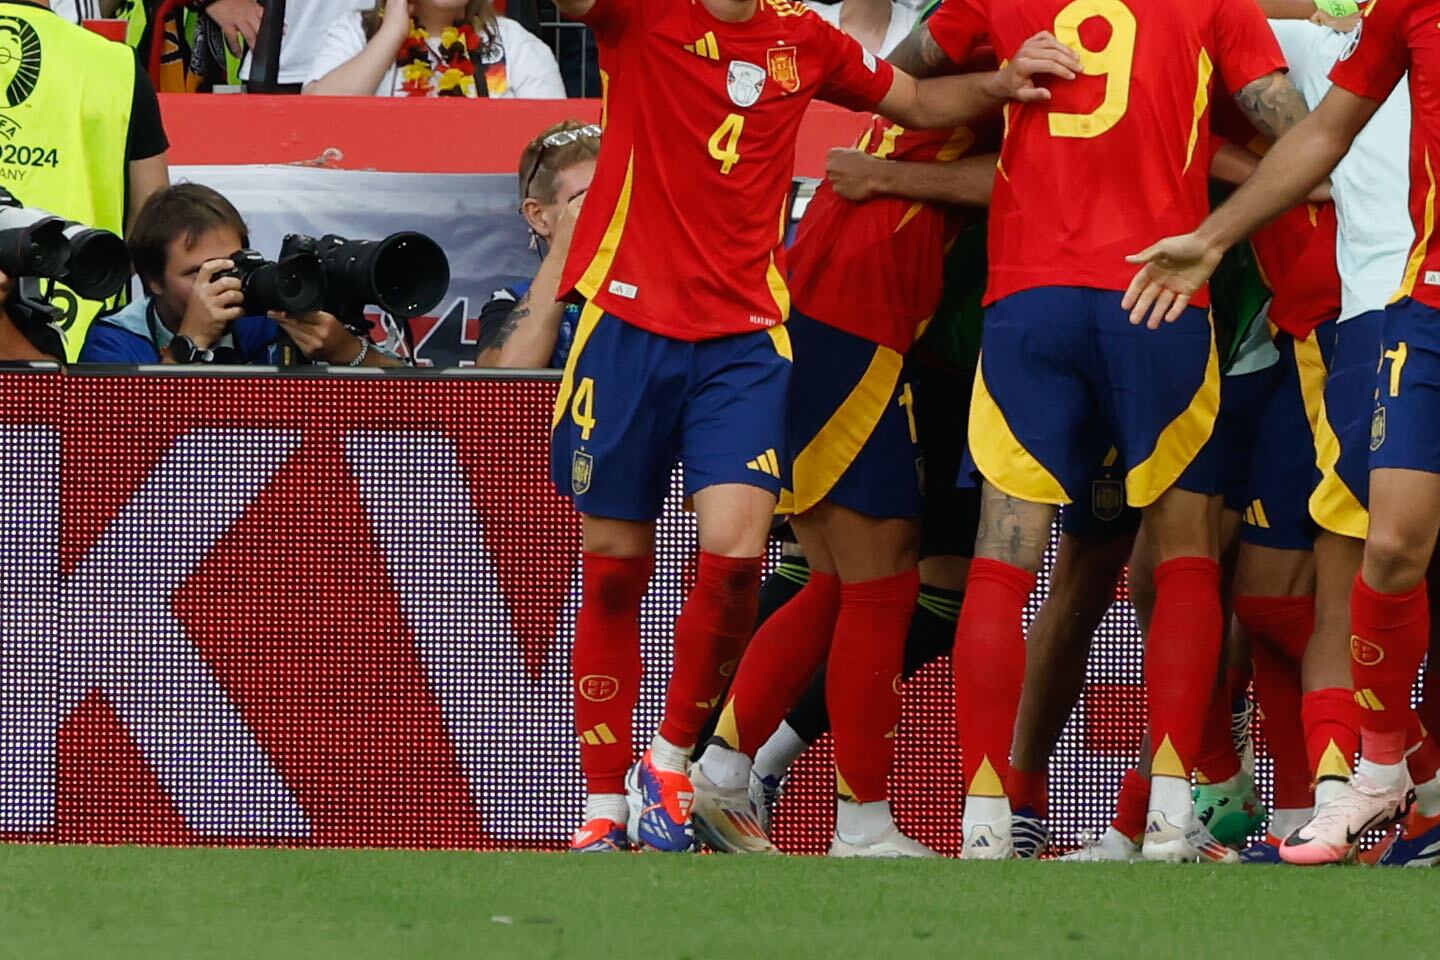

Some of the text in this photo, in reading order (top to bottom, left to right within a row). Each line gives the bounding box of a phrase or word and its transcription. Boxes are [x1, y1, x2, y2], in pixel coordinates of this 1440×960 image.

[0, 144, 59, 168] 2024
[707, 113, 745, 175] 4
[571, 377, 596, 441] 4
